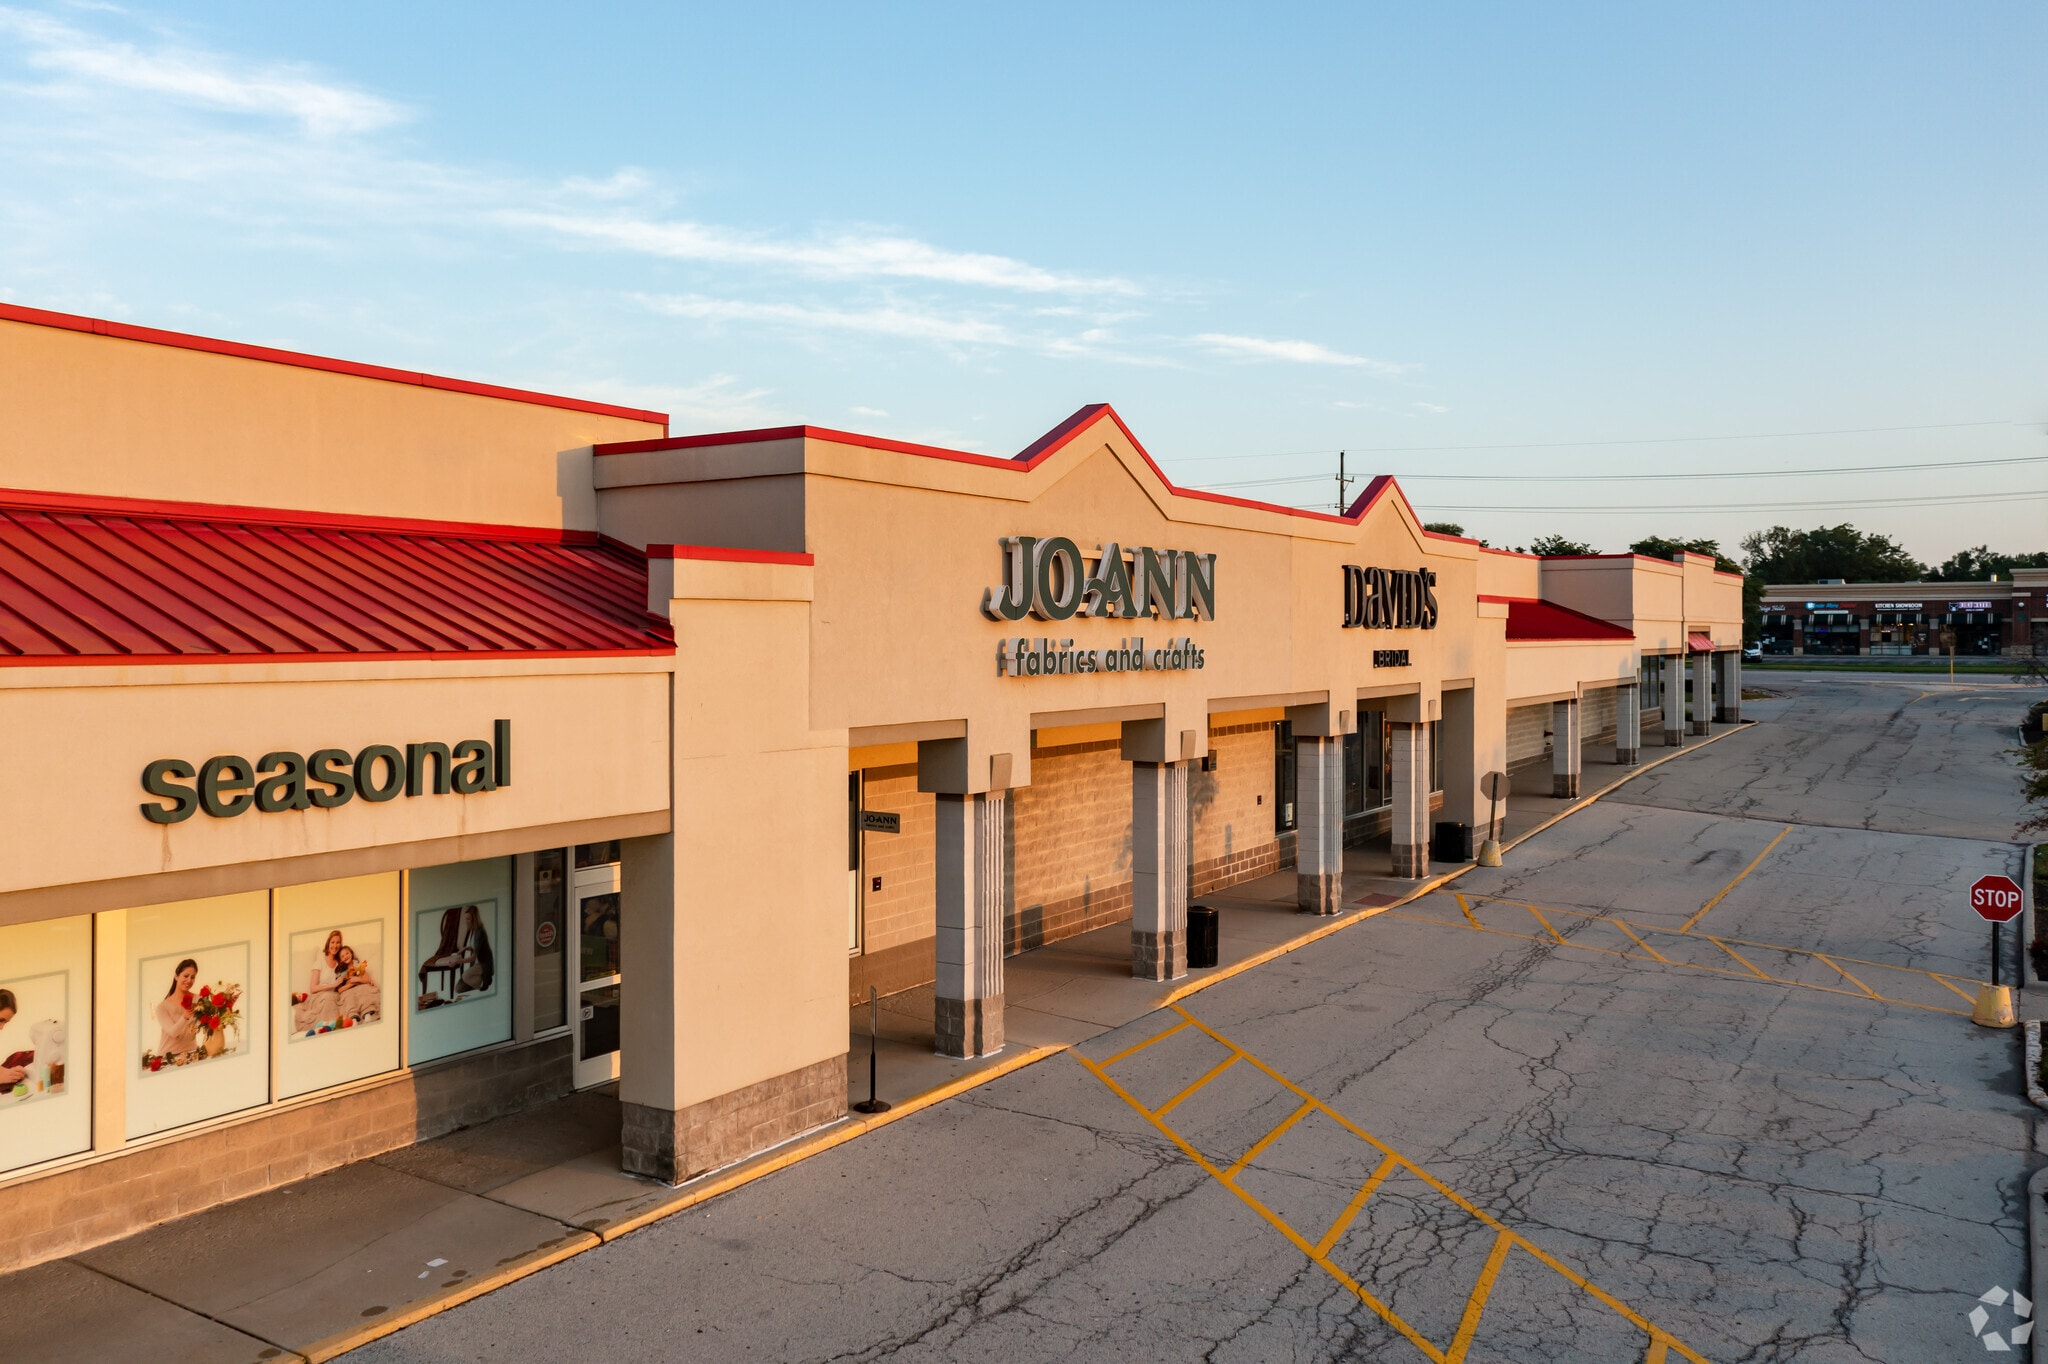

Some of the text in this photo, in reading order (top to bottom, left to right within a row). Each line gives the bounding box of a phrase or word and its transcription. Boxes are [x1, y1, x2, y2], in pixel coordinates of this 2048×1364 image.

[1006, 636, 1205, 677] fabrics and crafts
[1374, 649, 1412, 667] BRIDAL
[140, 719, 511, 824] seasonal
[1974, 889, 2019, 908] STOP
